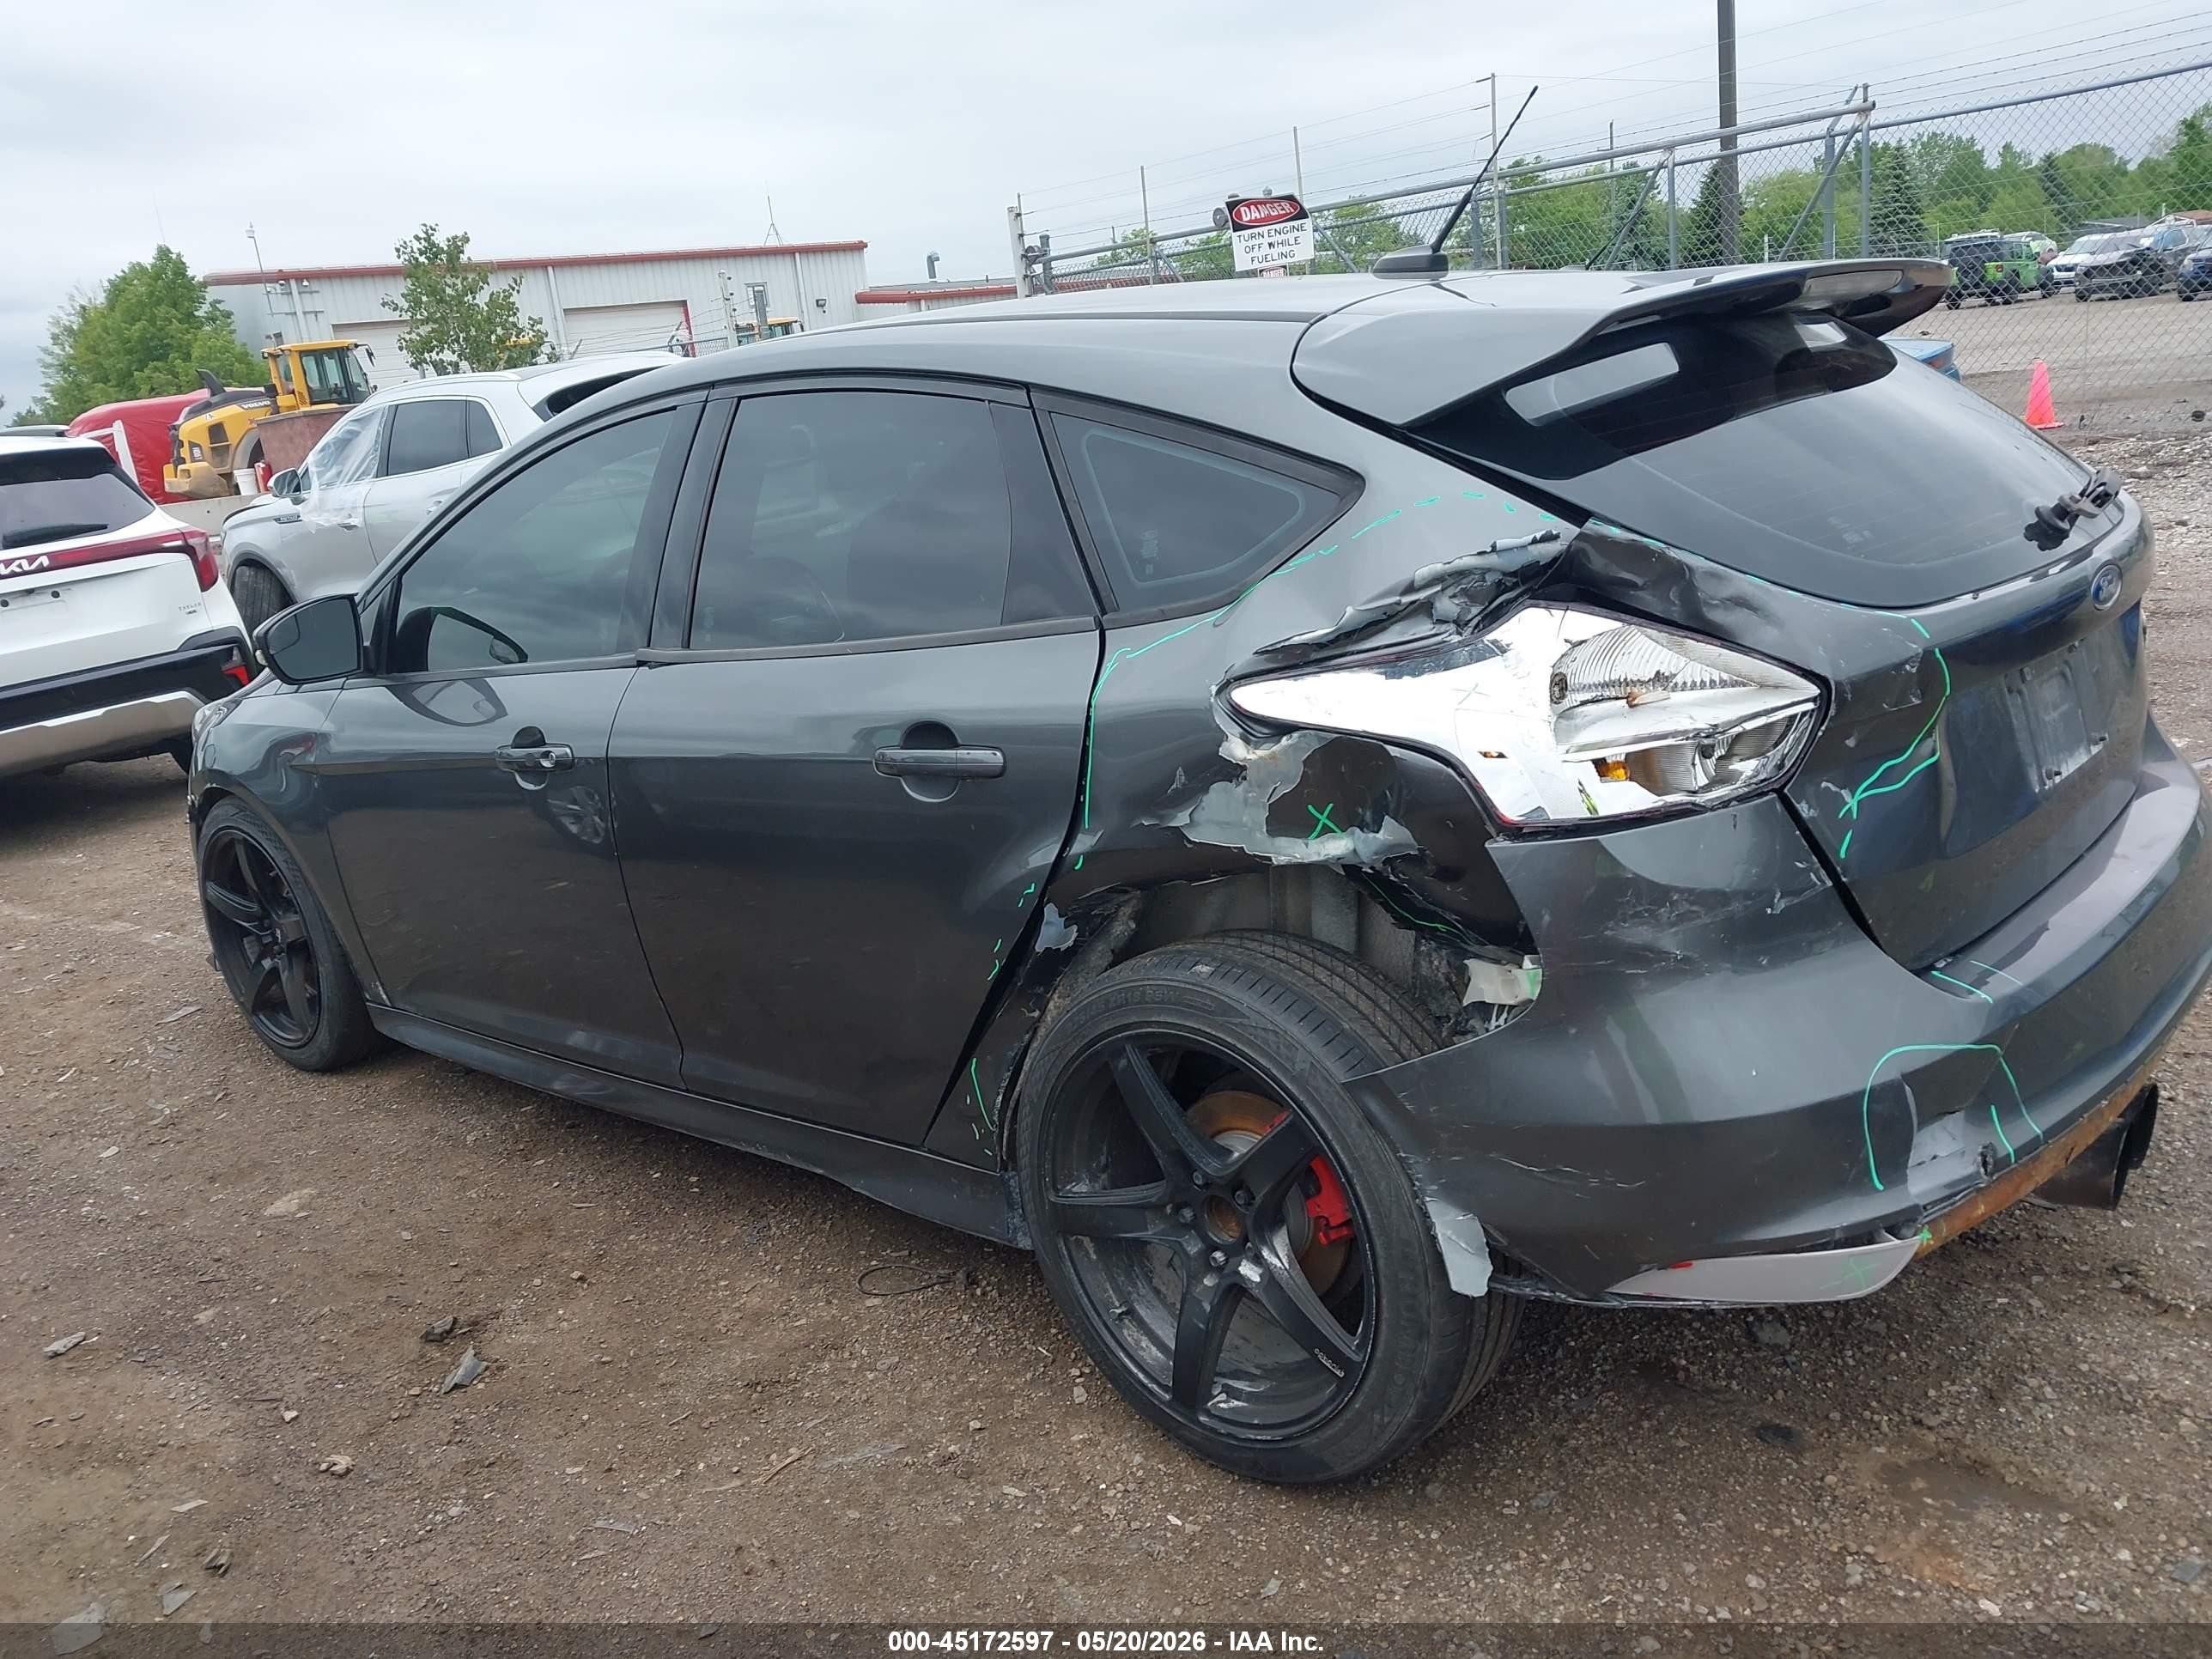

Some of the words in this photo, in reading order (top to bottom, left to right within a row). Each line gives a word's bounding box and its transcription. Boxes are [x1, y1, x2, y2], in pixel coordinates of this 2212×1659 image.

[1240, 202, 1294, 221] DANGER
[1237, 230, 1265, 244] TURN
[1267, 223, 1307, 238] ENGINE
[1244, 242, 1264, 255] OFF
[1267, 236, 1301, 251] WHILE
[1250, 249, 1296, 265] FUELING
